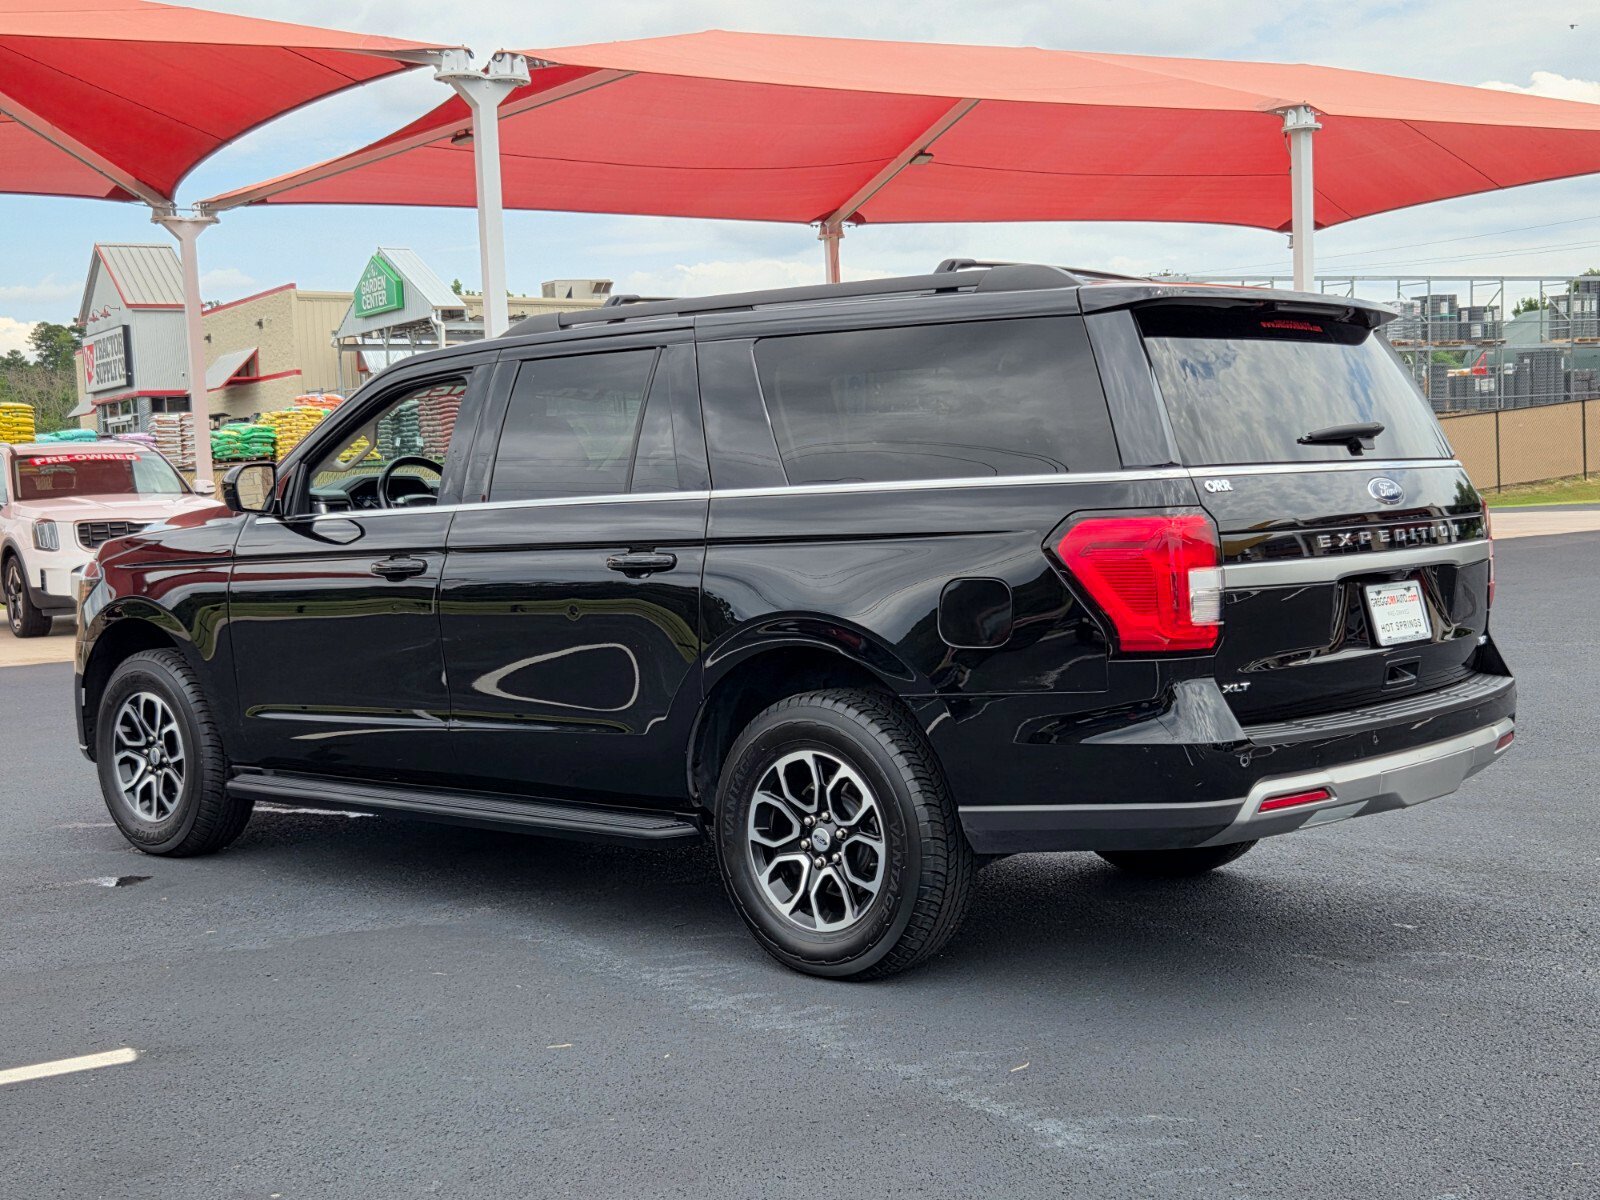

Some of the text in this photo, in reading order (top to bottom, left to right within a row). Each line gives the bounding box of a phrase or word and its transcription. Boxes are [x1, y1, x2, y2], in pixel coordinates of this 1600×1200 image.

[361, 274, 386, 295] GARDEN
[362, 290, 387, 310] CENTER
[94, 332, 123, 361] TRACTOR
[95, 358, 118, 385] SUPPLY
[33, 453, 138, 466] PRE-OWNED
[1203, 479, 1234, 493] ORR
[1378, 482, 1400, 497] Ford
[1317, 523, 1460, 548] EXPEDITION
[1381, 618, 1422, 633] HOT SPRINGS
[1222, 682, 1251, 694] XLT
